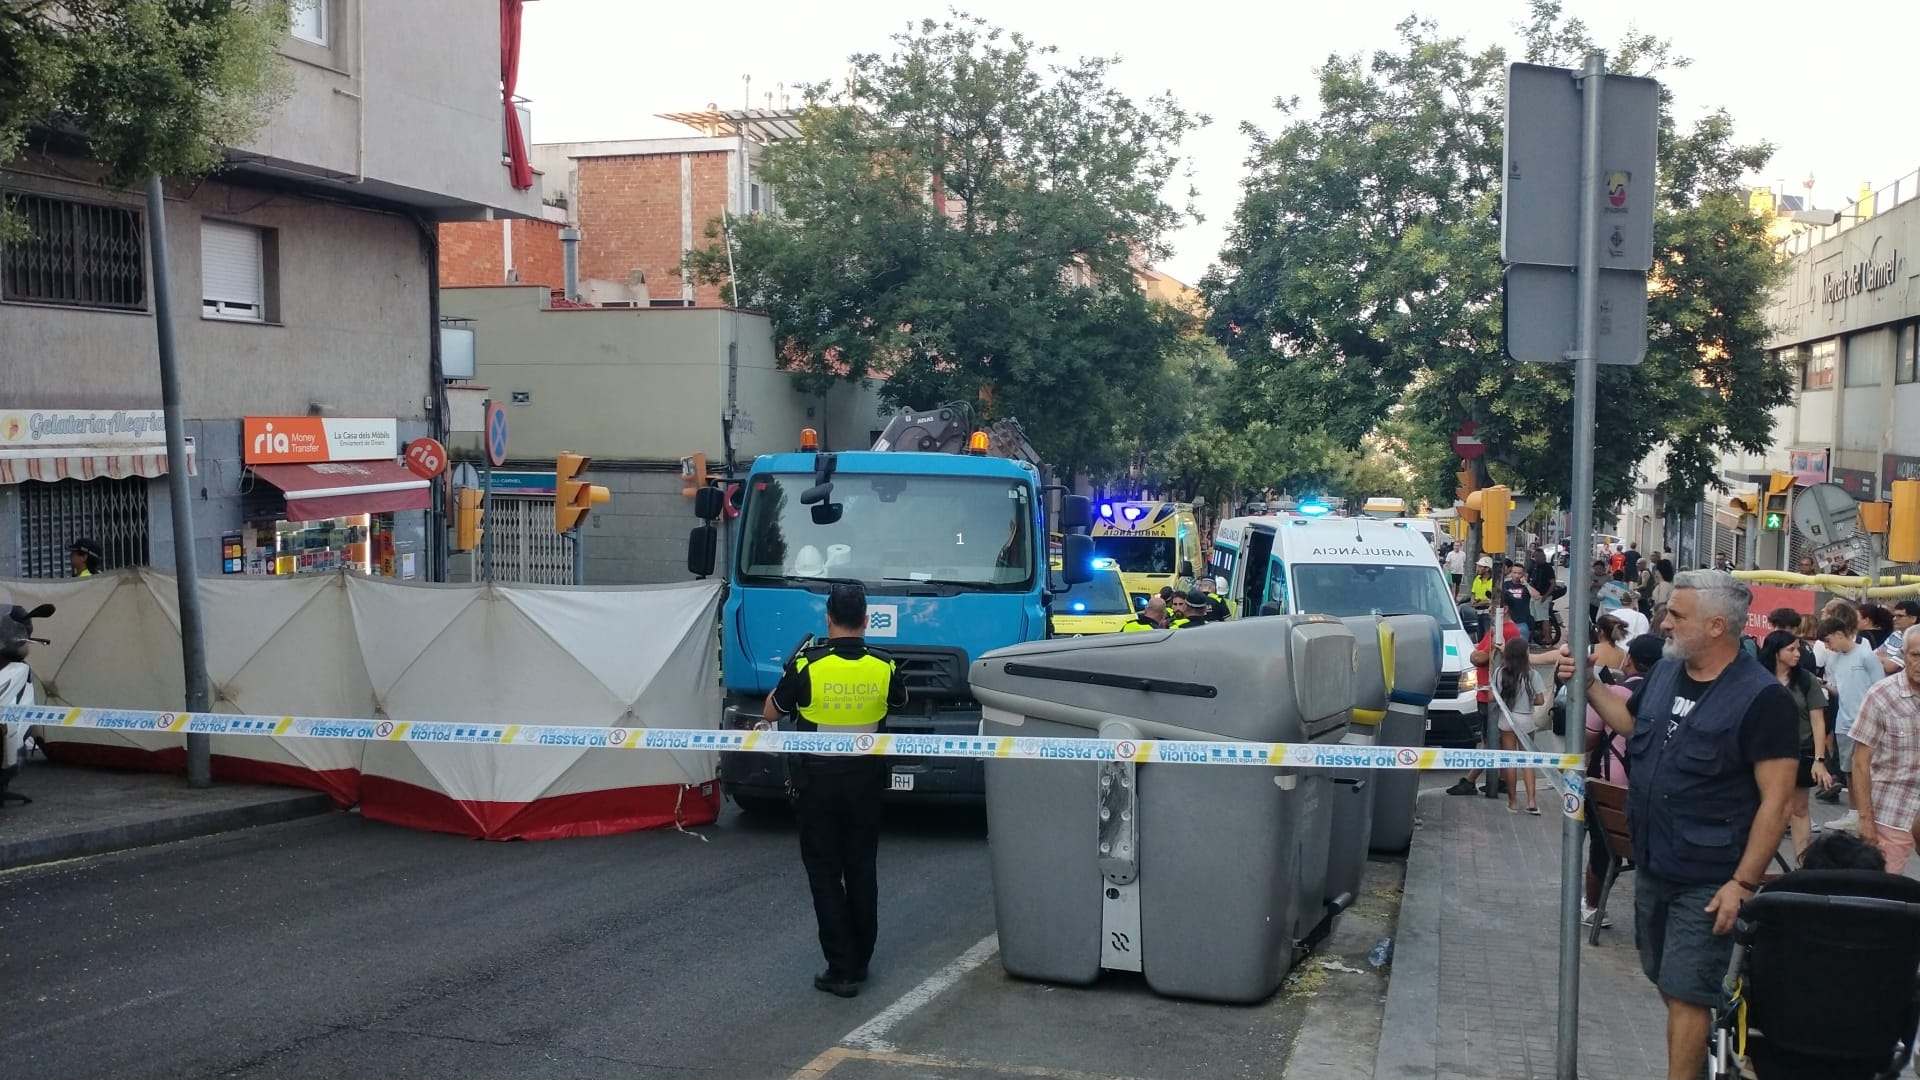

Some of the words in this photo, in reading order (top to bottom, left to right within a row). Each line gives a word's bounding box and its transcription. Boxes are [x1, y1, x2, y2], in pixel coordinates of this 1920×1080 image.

[1822, 269, 1848, 304] Mercat
[1848, 262, 1863, 296] del
[1863, 248, 1897, 292] Carmel
[30, 412, 106, 440] Gelateria
[254, 422, 289, 454] ria
[292, 433, 316, 443] Money
[343, 431, 357, 439] Casa
[292, 444, 320, 453] Transfer
[411, 445, 439, 471] ria
[823, 682, 880, 696] POLICIA
[95, 718, 138, 729] PASSEU
[140, 719, 156, 730] NO
[189, 723, 228, 732] POLICIA
[310, 727, 354, 738] PASSEU
[358, 728, 375, 738] NO
[411, 730, 452, 740] POLICIA
[539, 735, 586, 745] PASSEU
[589, 736, 606, 745] NO
[646, 738, 689, 748] POLICIA
[783, 740, 832, 751] PASSEU
[834, 741, 854, 752] NO
[895, 744, 940, 754] POLICIA
[1039, 747, 1092, 759] PASSEU
[1096, 749, 1116, 760] NO
[1159, 751, 1207, 762] POLICIA
[1315, 755, 1371, 766] PASSEU
[1376, 757, 1397, 767] NO
[1443, 758, 1495, 768] POLICIA
[895, 775, 910, 788] RH
